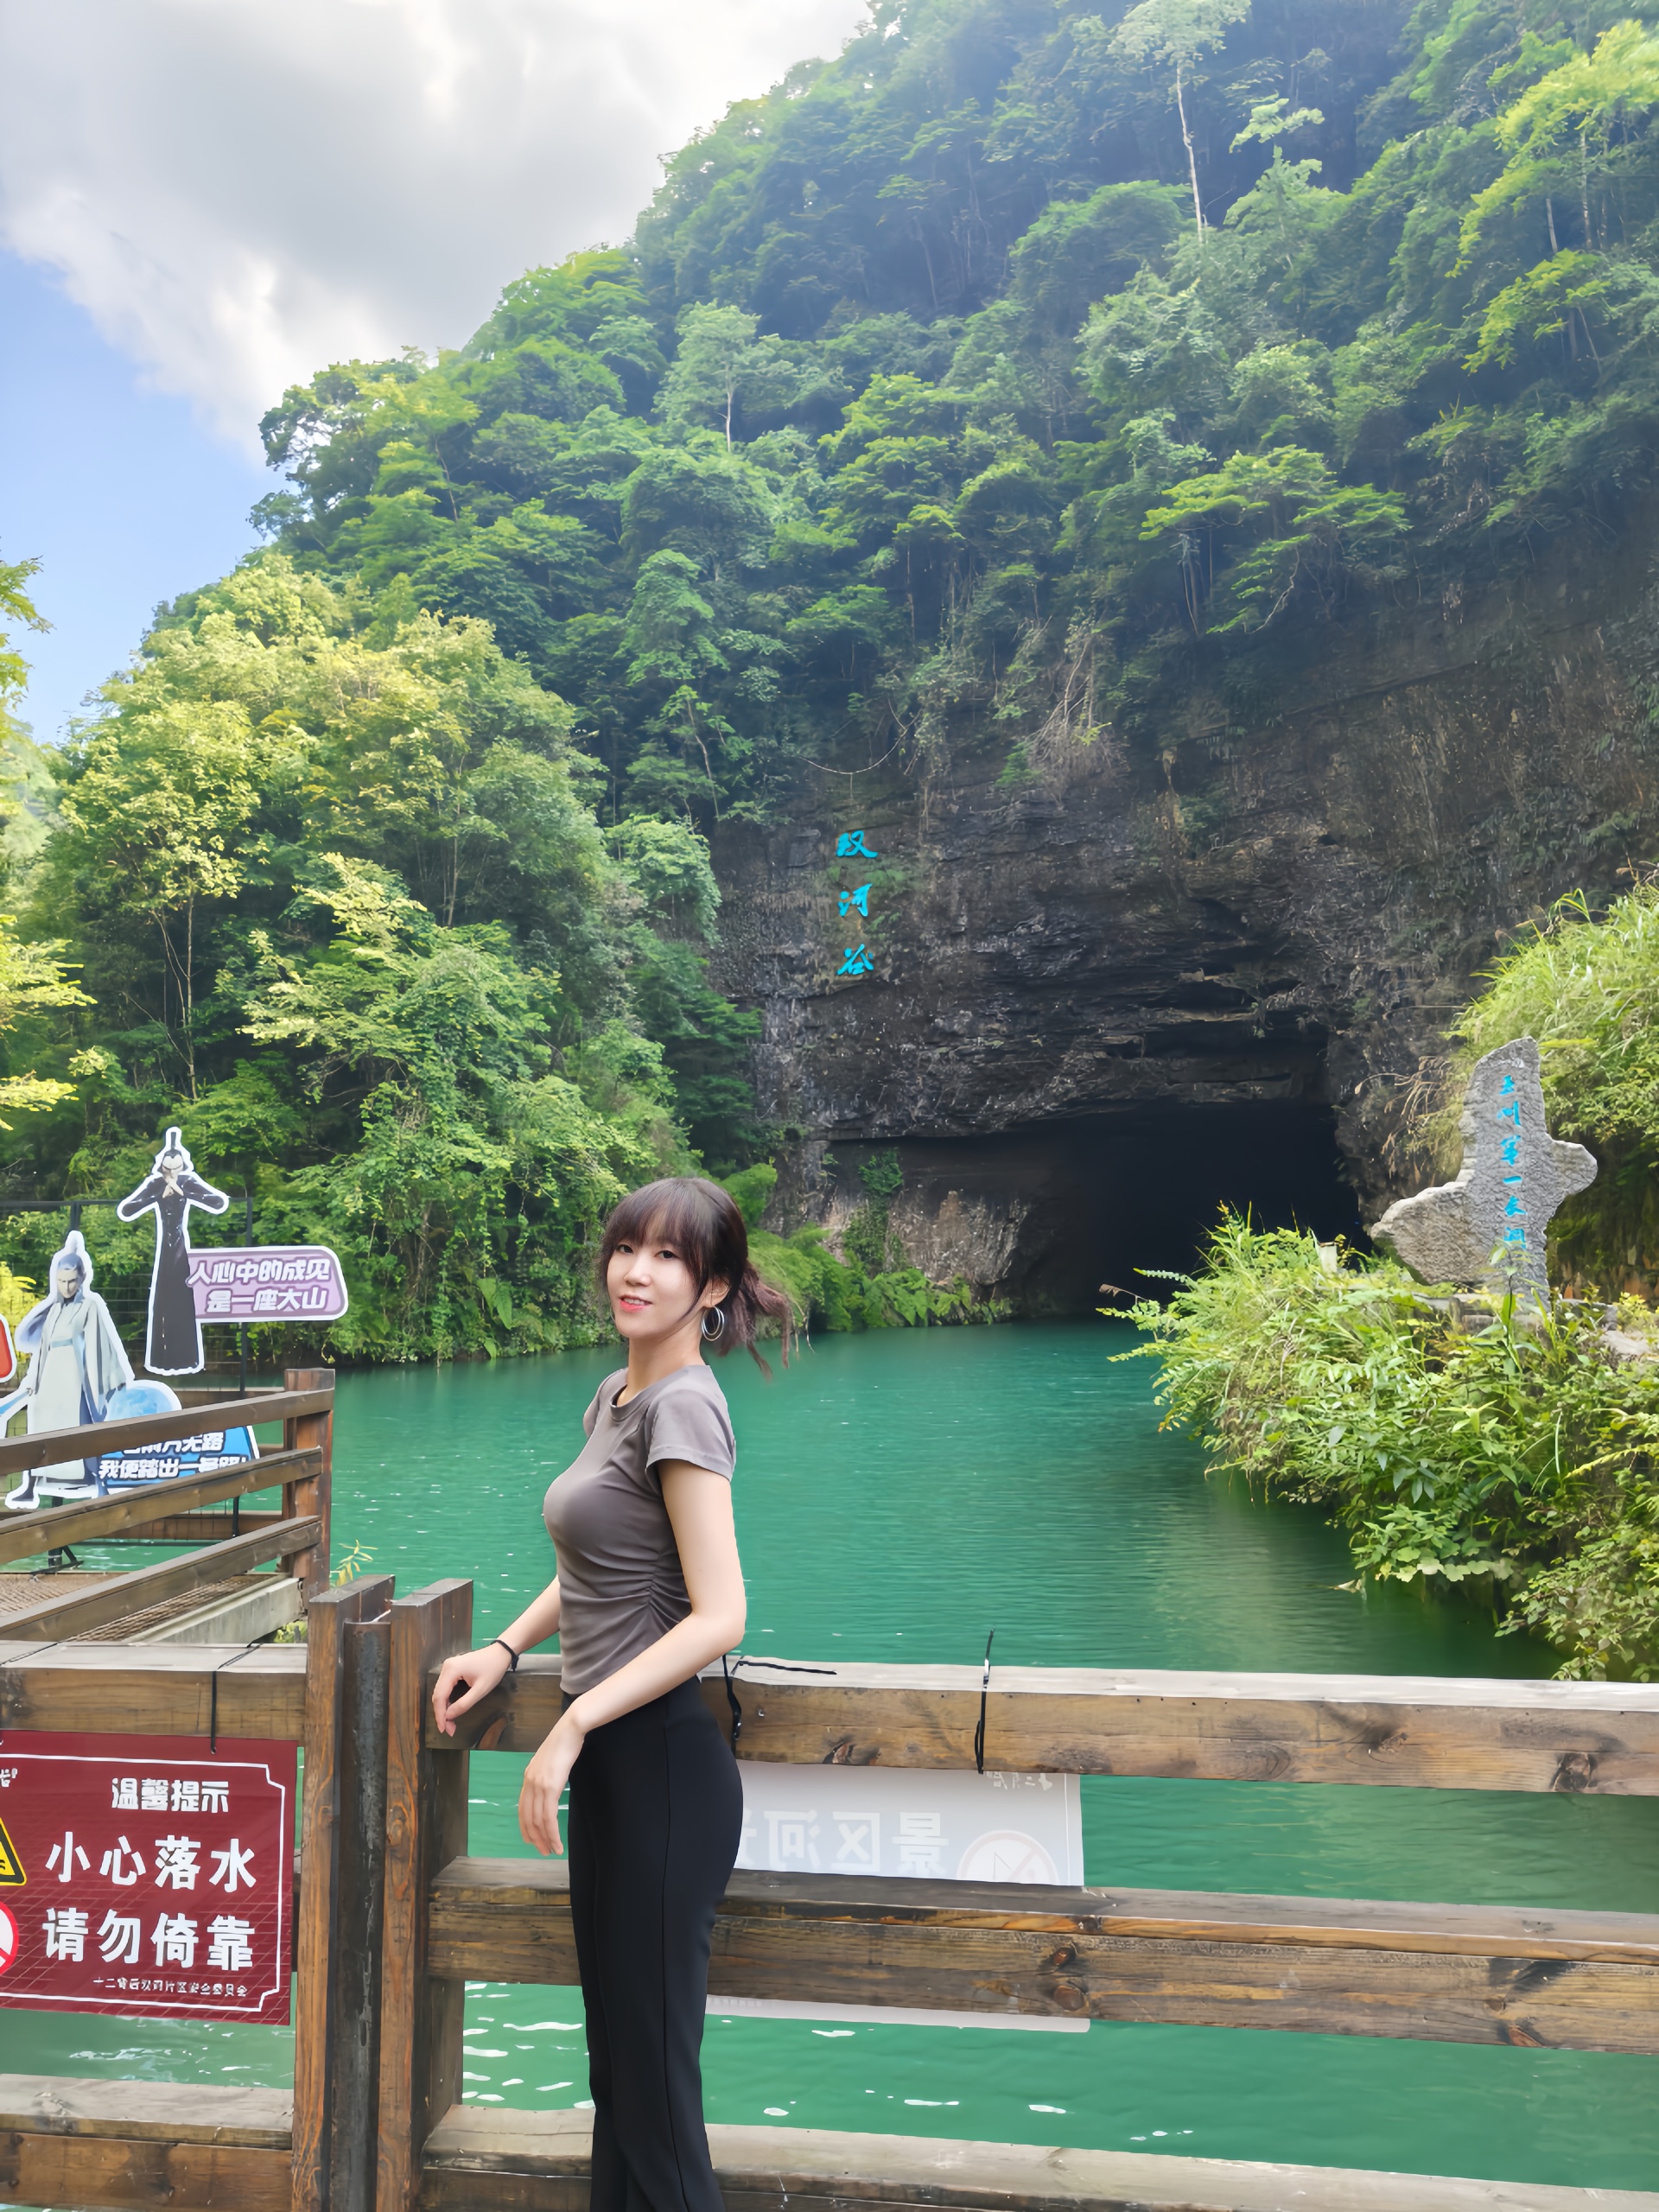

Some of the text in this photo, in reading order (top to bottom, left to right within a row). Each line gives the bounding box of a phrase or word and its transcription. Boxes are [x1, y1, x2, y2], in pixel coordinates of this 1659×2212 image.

[836, 830, 879, 976] 双河谷
[187, 1258, 331, 1286] 人心中的成见
[206, 1287, 328, 1313] 是一座大山
[111, 1777, 229, 1814] 温馨提示
[45, 1831, 257, 1893] 小心落水
[41, 1907, 256, 1972] 请勿倚靠
